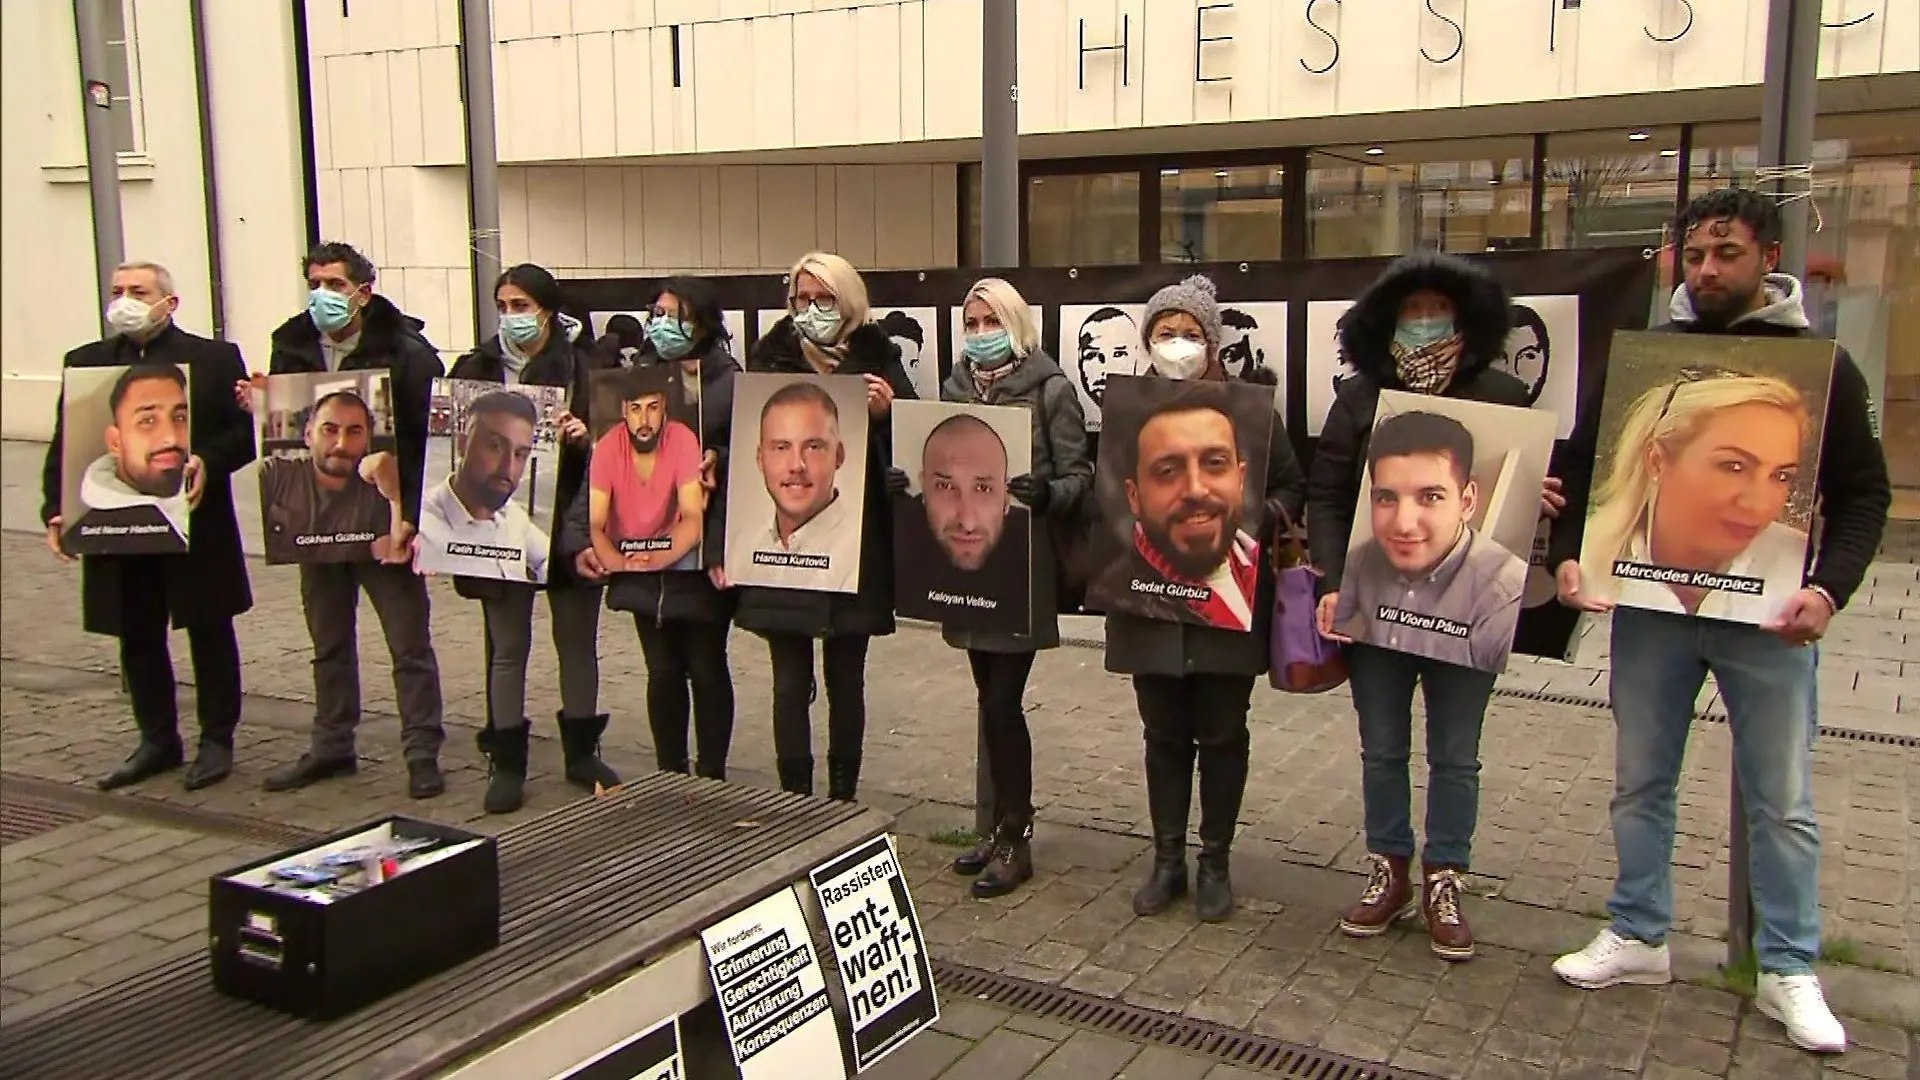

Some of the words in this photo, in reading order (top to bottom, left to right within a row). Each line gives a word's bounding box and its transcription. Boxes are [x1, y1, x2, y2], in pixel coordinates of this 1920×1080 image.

[754, 552, 788, 564] Hamza
[1614, 562, 1690, 584] Mercedes
[1691, 572, 1762, 593] Kierpacz
[928, 589, 965, 605] Kaloyan
[966, 594, 997, 609] Velkov
[1131, 579, 1165, 594] Sedat
[1166, 583, 1210, 600] Gürbüz
[1379, 606, 1400, 621] Vili
[1400, 610, 1435, 629] Viorel
[821, 858, 894, 909] Rassisten
[710, 941, 727, 955] Wir
[834, 897, 890, 949] ent-
[717, 933, 788, 982] Erinnerung
[723, 947, 810, 1008] Gerechtigkeit
[841, 919, 912, 986] waff-
[732, 981, 802, 1034] Aufklärung
[850, 953, 913, 1023] nen!
[735, 992, 829, 1060] Konsequenzen
